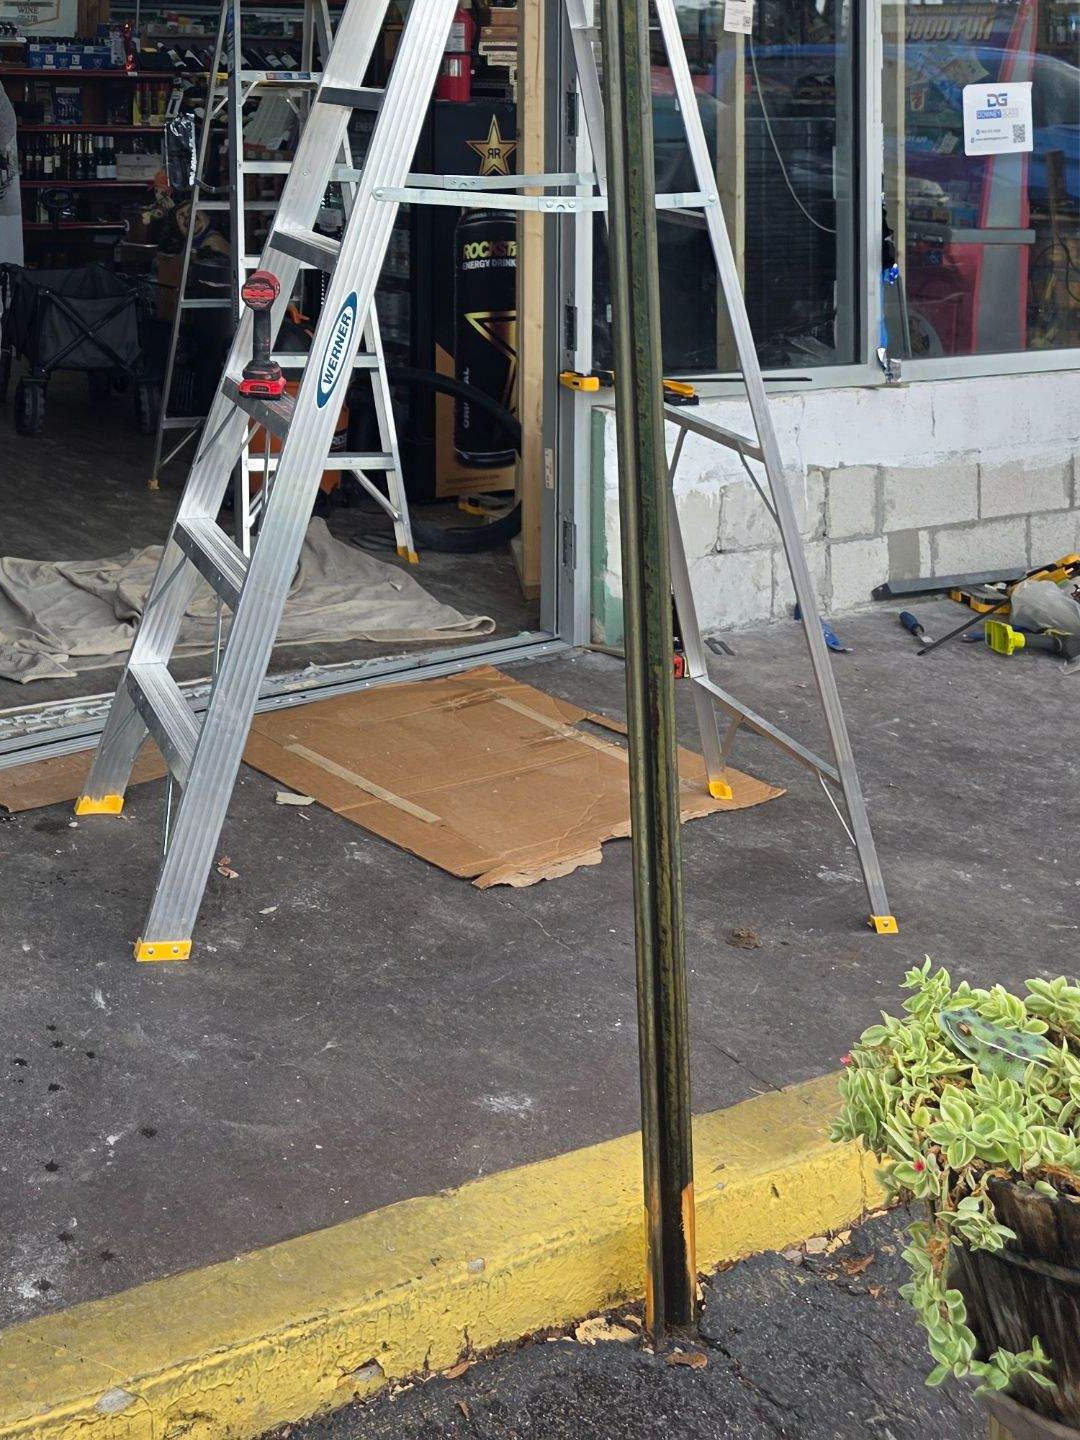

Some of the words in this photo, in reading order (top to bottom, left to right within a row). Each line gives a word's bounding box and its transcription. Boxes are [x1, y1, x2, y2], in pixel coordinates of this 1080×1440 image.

[987, 93, 1008, 108] DG
[463, 240, 518, 259] ROCKST
[462, 259, 490, 270] ENERGY
[323, 313, 351, 385] WERNER
